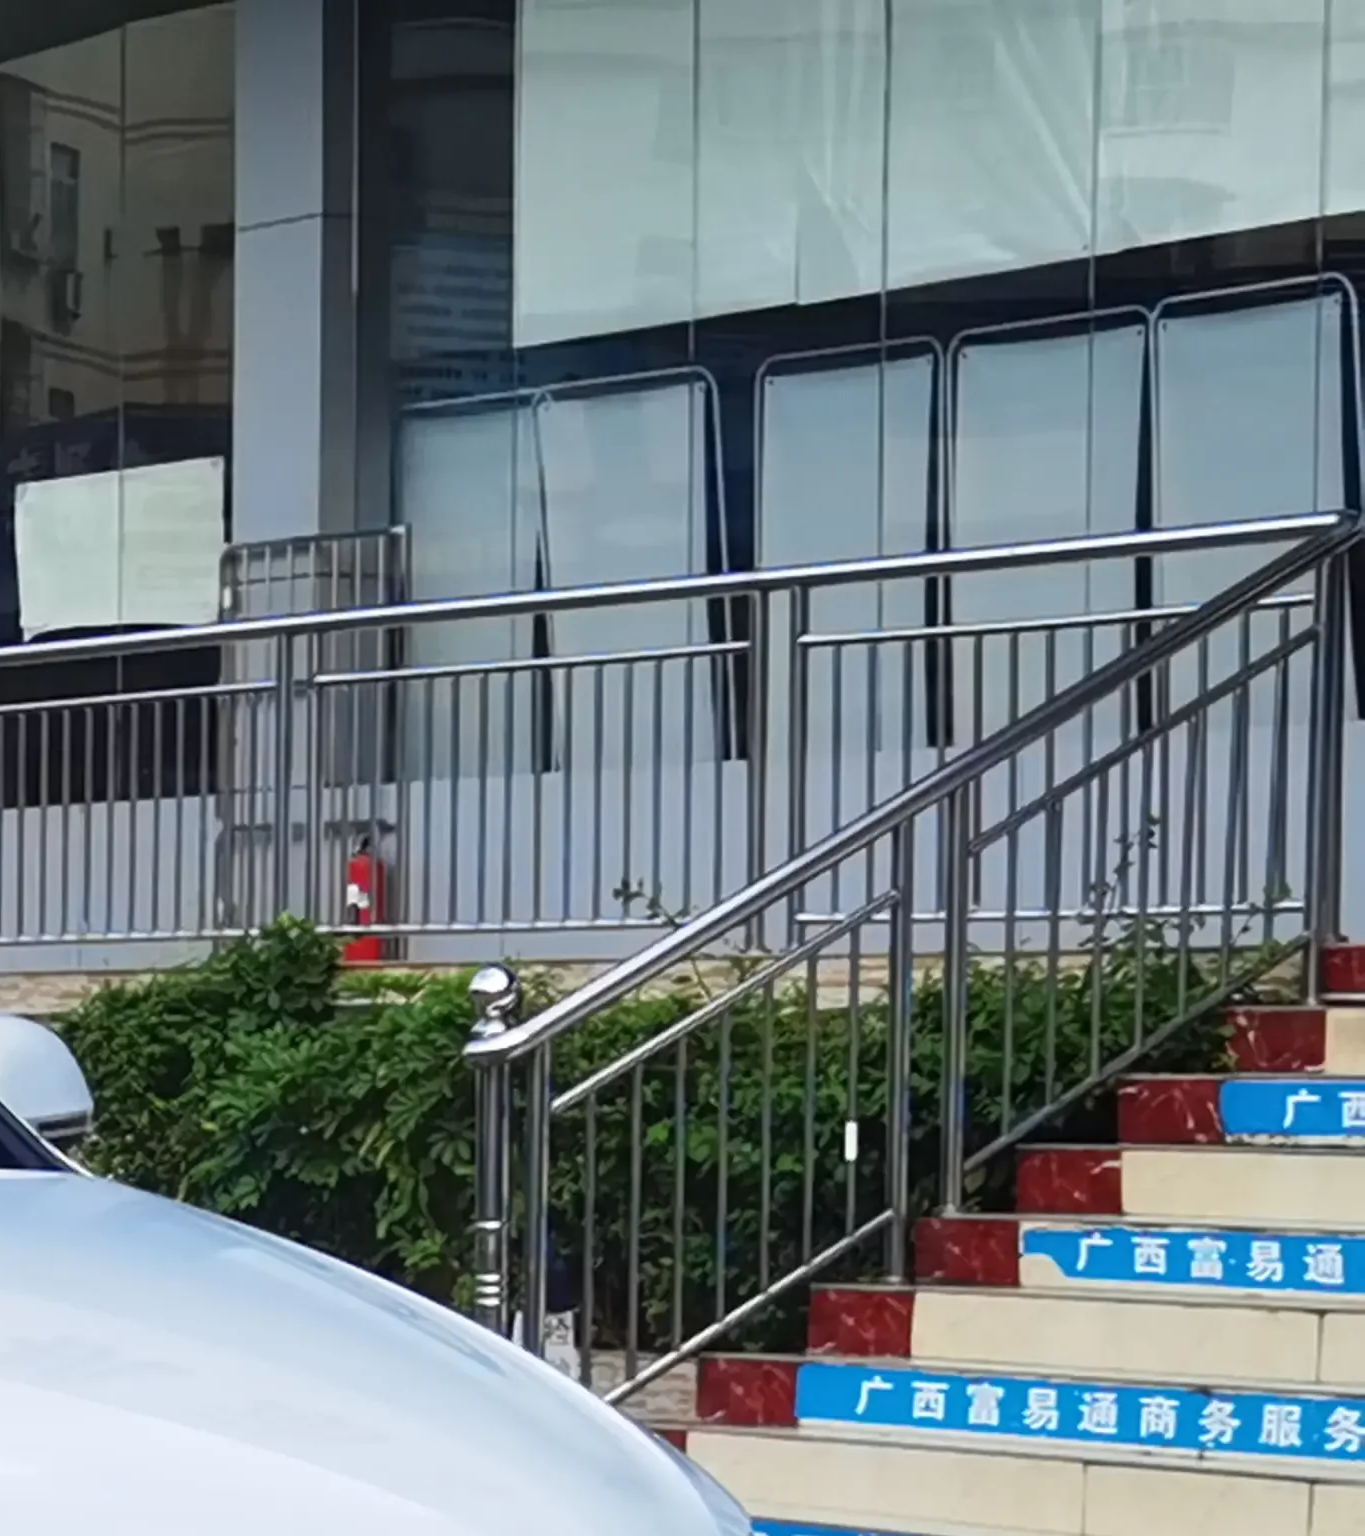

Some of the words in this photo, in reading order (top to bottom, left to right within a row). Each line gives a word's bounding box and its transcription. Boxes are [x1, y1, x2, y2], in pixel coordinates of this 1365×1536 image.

[1283, 1088, 1365, 1129] 广西
[1077, 1232, 1345, 1285] 广西富易通
[855, 1375, 1365, 1453] 广西富易通商务服务
